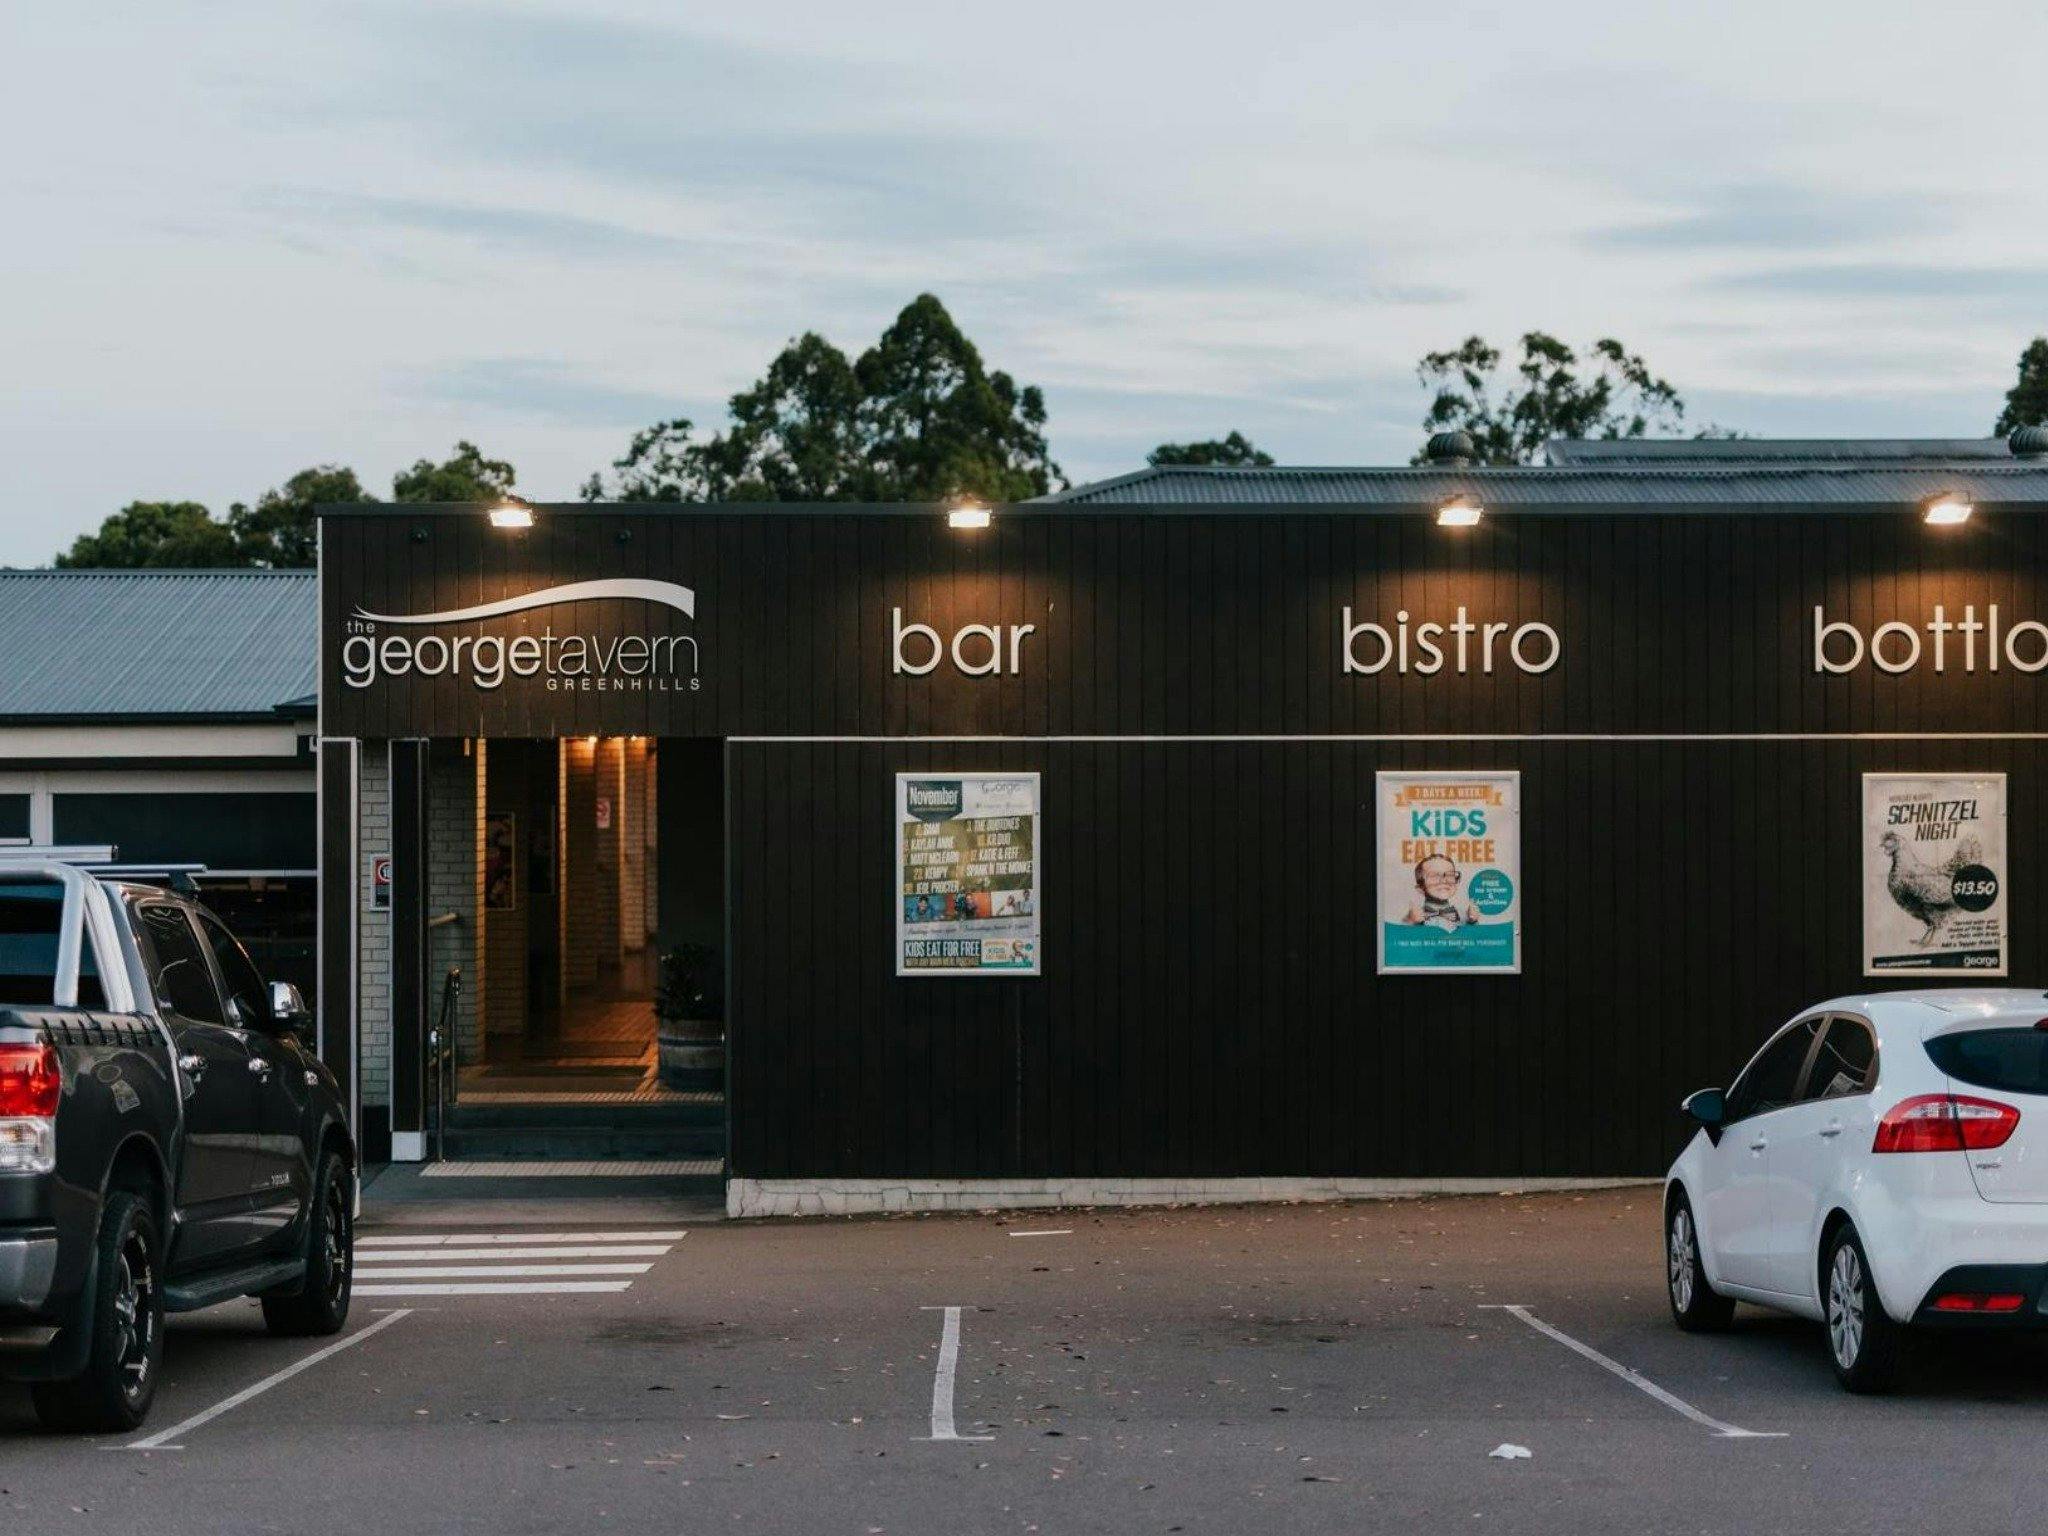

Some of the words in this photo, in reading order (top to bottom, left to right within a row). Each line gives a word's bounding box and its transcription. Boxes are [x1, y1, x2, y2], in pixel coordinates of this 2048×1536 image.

[346, 620, 376, 634] the
[893, 607, 1035, 676] bar
[1342, 606, 1561, 674] bistro
[1814, 604, 2048, 674] bottlo
[546, 678, 702, 691] GREENHILLS
[909, 787, 959, 806] November
[1887, 799, 1979, 825] SCHNITZEL
[1915, 821, 1962, 841] NIGHT
[1402, 840, 1437, 863] EAT
[1446, 839, 1495, 863] FREE
[1953, 881, 1996, 895] $13.50
[905, 941, 925, 957] KIDS
[926, 941, 941, 956] EAT
[943, 941, 959, 956] FOR
[960, 940, 980, 956] FREE
